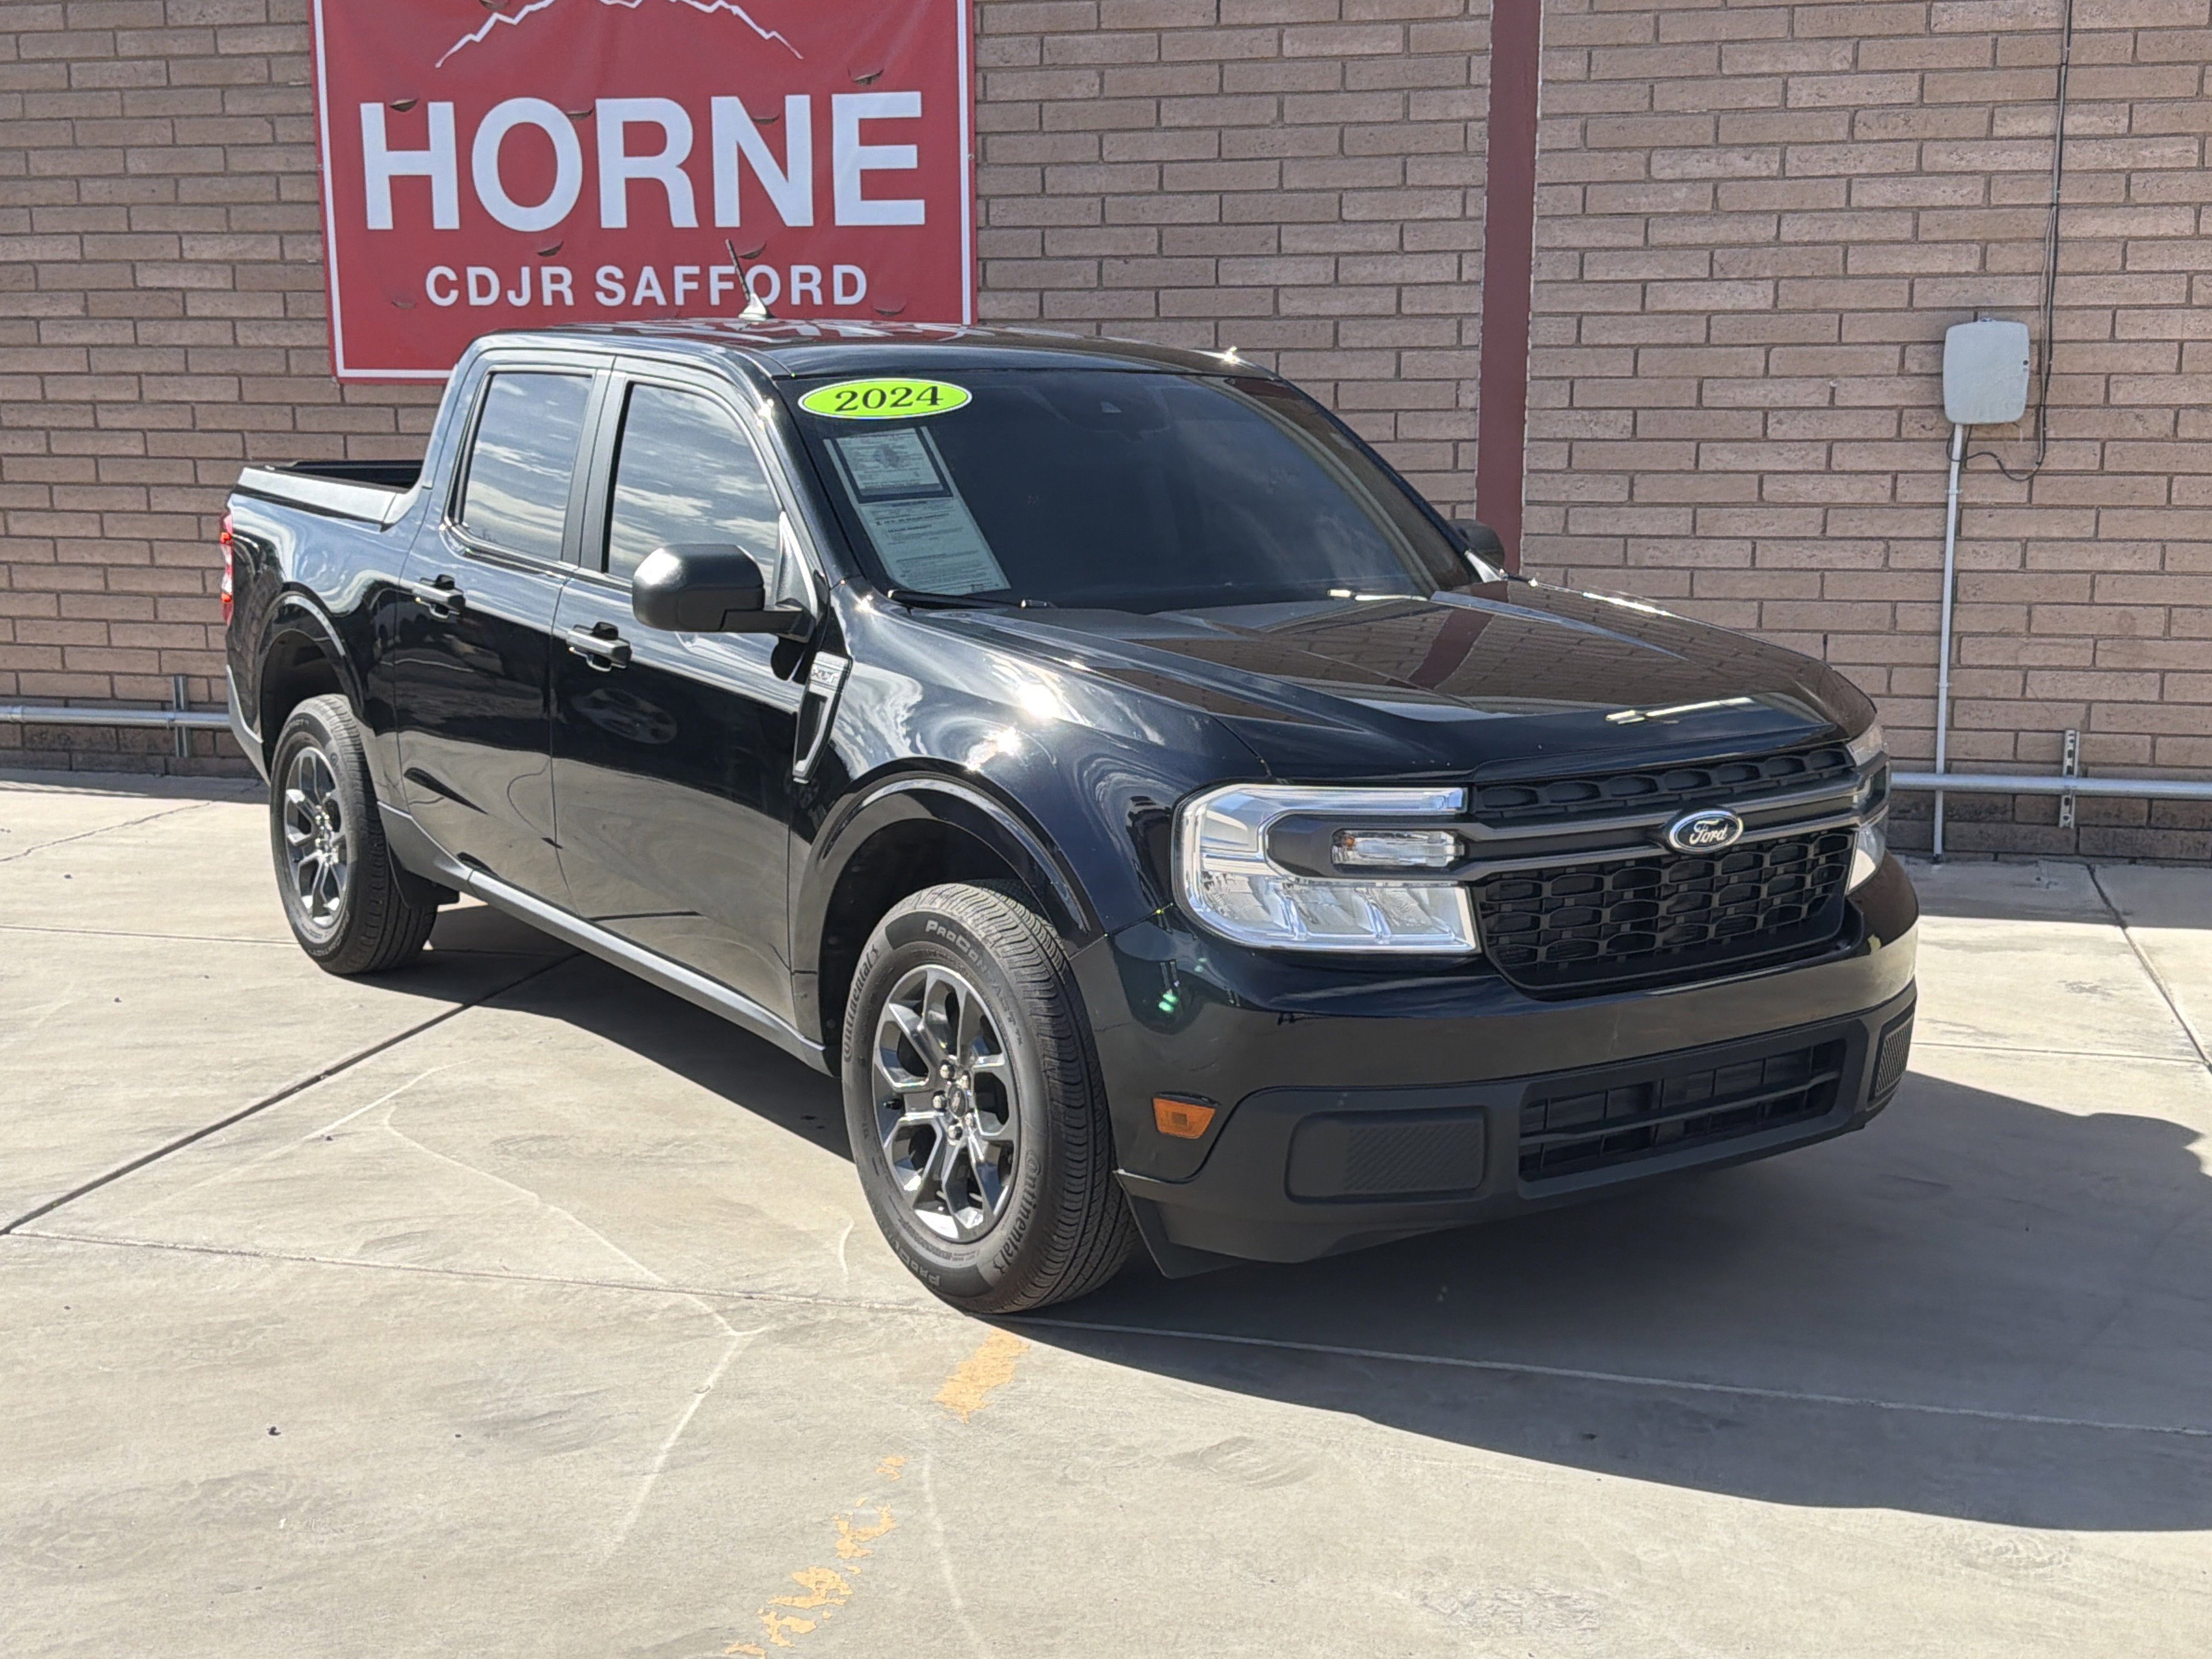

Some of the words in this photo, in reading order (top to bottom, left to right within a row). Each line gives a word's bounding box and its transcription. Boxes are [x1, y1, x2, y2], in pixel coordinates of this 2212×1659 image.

[359, 91, 926, 233] HORNE
[425, 265, 574, 307] CDJR
[595, 264, 867, 307] SAFFORD
[834, 386, 944, 412] 2024
[1689, 818, 1729, 845] Ford
[1000, 1150, 1042, 1267] Continental
